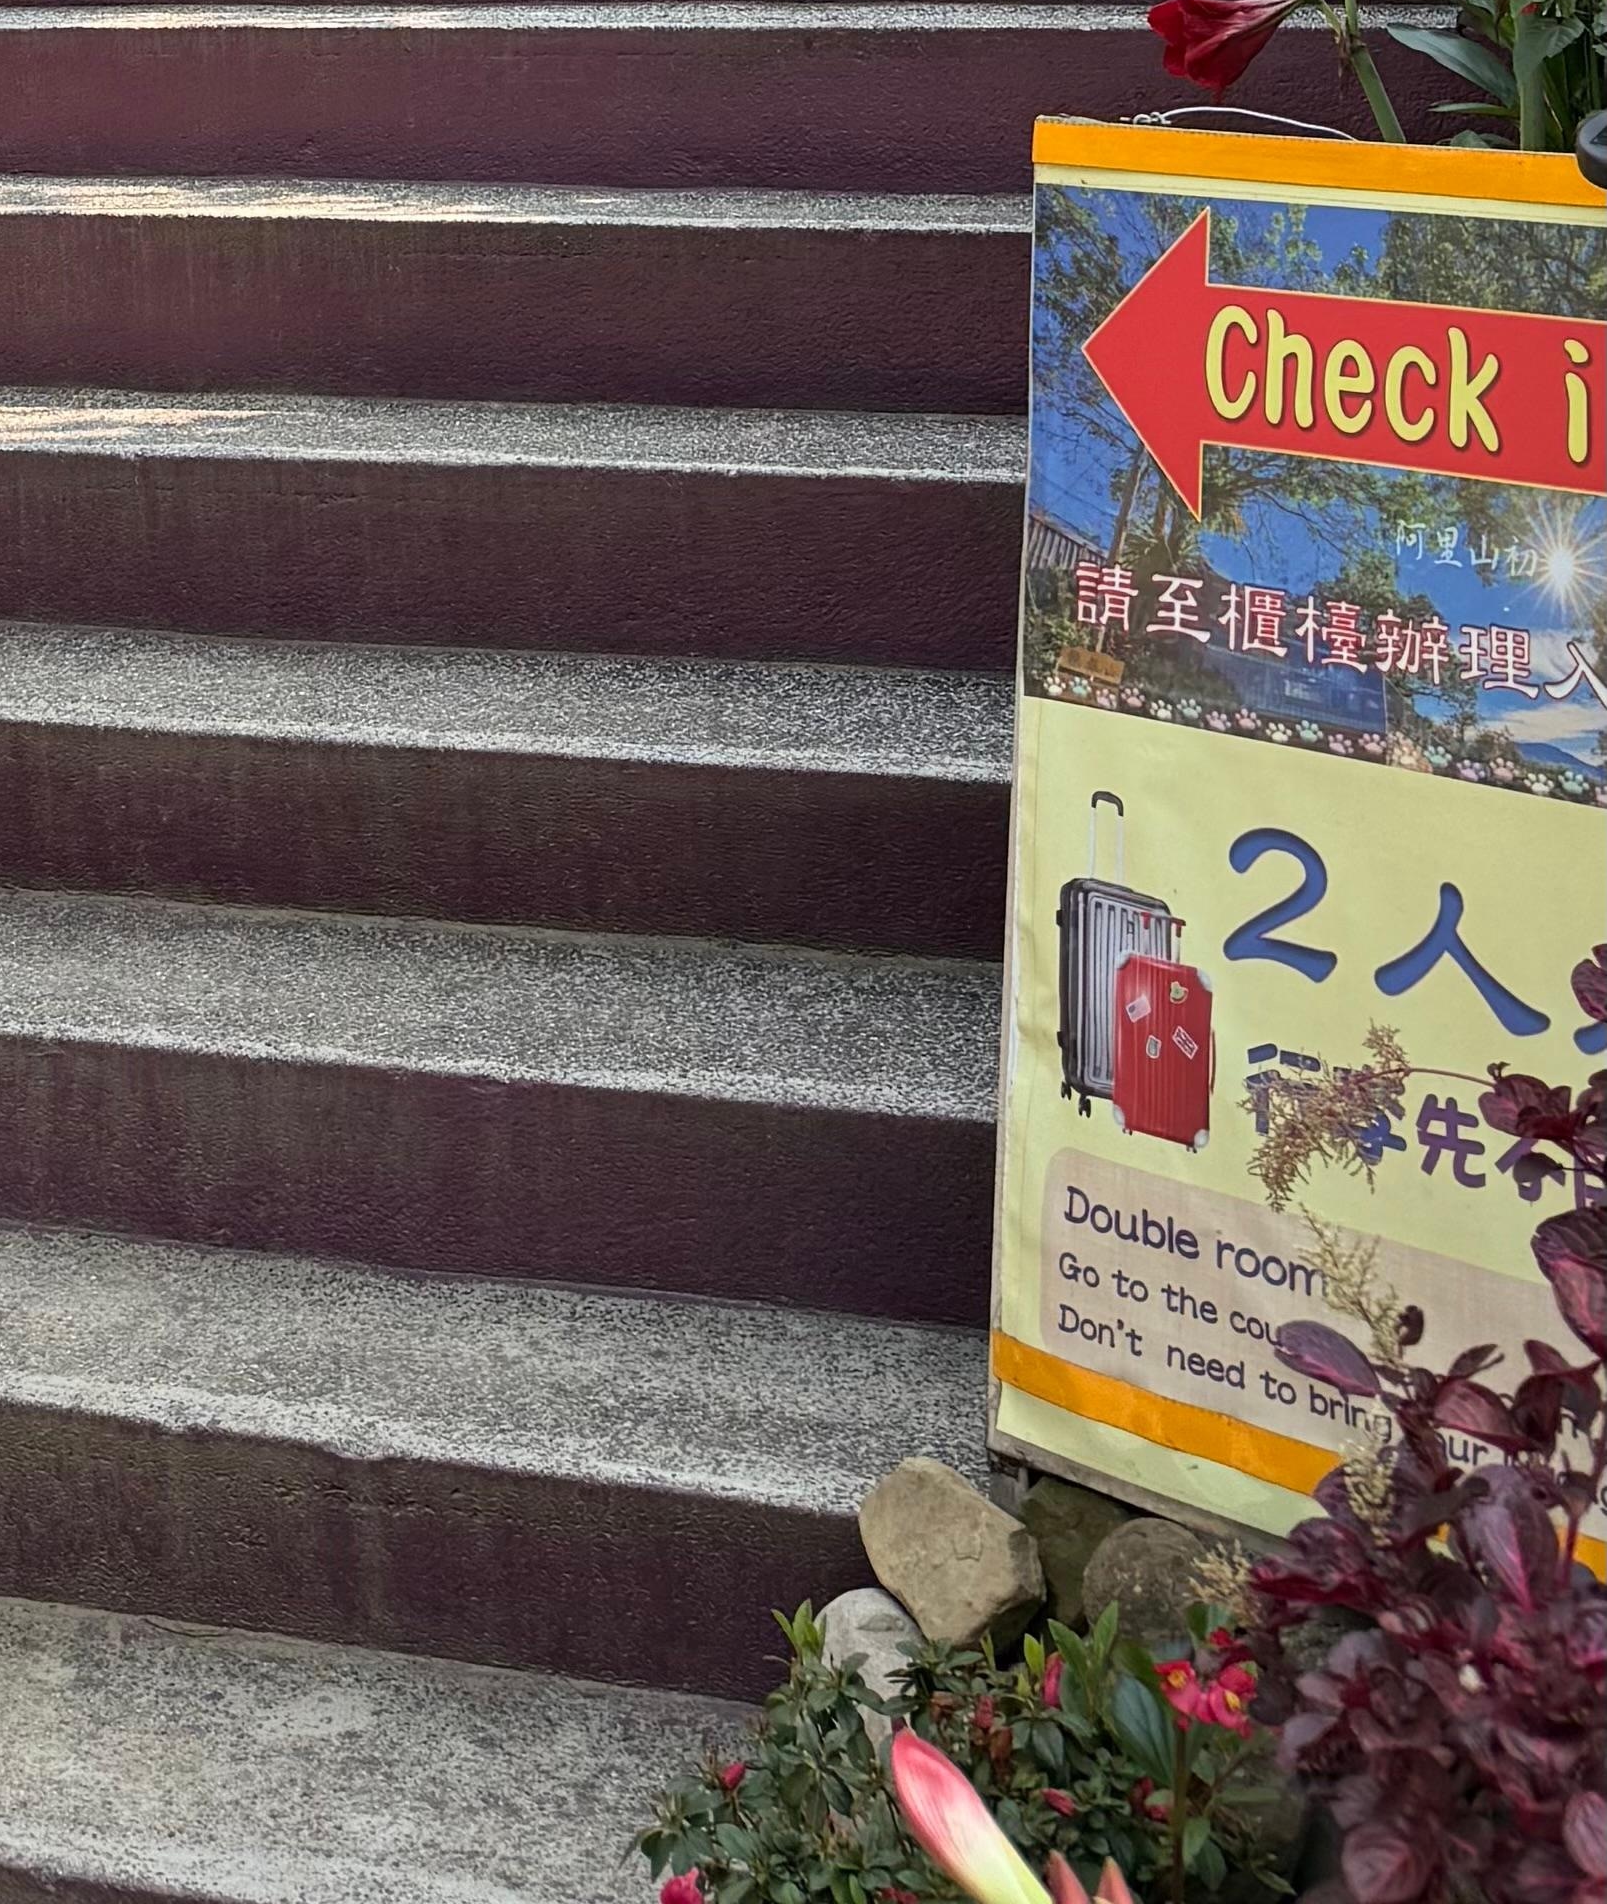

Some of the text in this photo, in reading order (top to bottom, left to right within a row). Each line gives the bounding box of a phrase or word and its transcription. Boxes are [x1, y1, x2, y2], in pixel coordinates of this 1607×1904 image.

[1204, 304, 1501, 454] Check
[1223, 826, 1607, 1056] 2人
[1058, 1251, 1100, 1288] Go
[1111, 1269, 1149, 1303] to
[1161, 1283, 1218, 1325] the
[1063, 1185, 1330, 1298] Double room
[1058, 1304, 1143, 1357] Don't
[1166, 1344, 1245, 1390] need
[1259, 1370, 1297, 1406] to
[1308, 1383, 1393, 1444] bring
